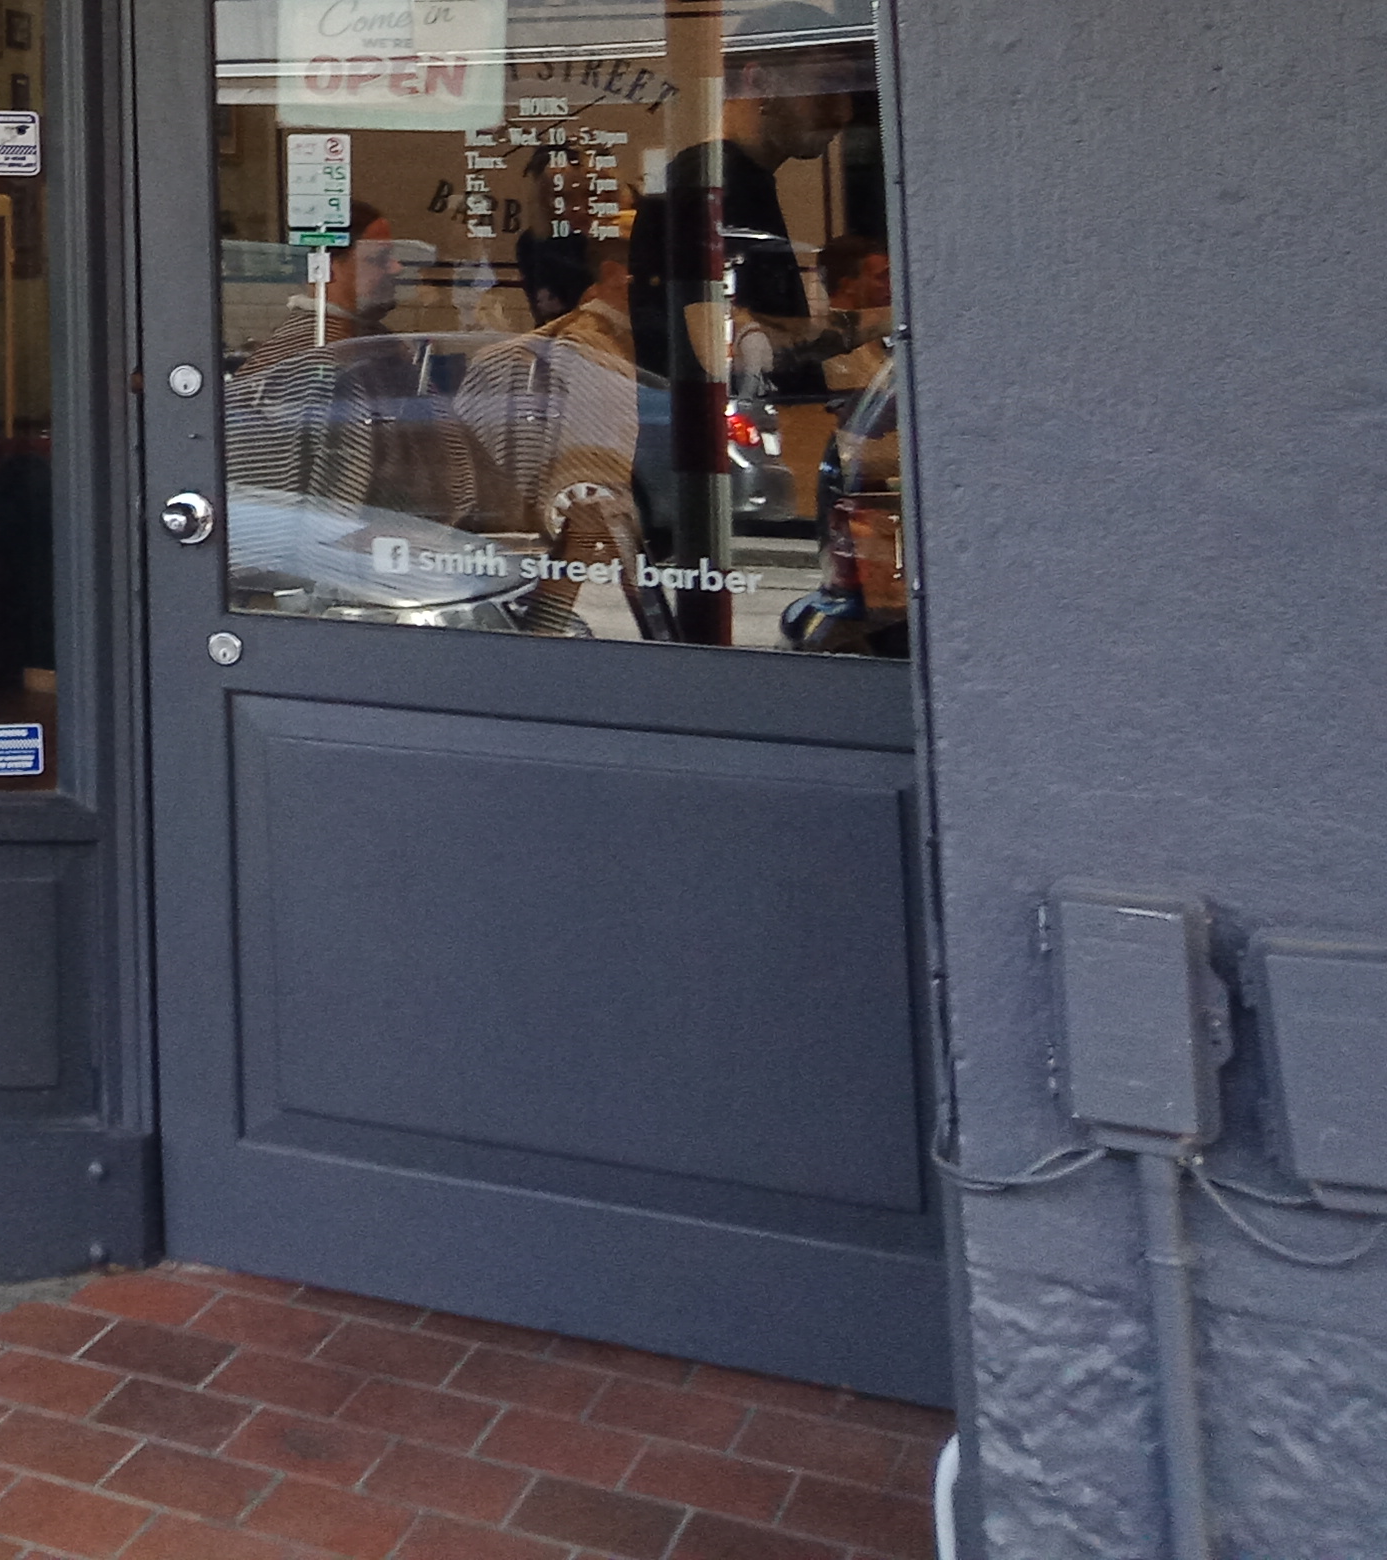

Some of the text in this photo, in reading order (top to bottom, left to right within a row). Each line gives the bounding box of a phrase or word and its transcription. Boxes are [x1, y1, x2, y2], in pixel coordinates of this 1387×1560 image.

[423, 5, 455, 25] in
[303, 54, 468, 97] OPEN
[519, 97, 569, 116] HOURS
[508, 127, 541, 146] Wed.
[548, 127, 566, 145] 10
[464, 151, 508, 169] Thurs.
[549, 150, 568, 168] 10
[585, 150, 618, 171] 7pm
[465, 174, 490, 192] Fri.
[553, 175, 564, 191] 9
[586, 174, 618, 194] 7pm
[554, 198, 565, 215] 9
[588, 197, 620, 217] 5pm
[466, 220, 497, 238] Sun.
[551, 220, 570, 238] 10
[589, 220, 620, 240] 4pm
[418, 542, 508, 578] smith
[519, 549, 624, 586] street
[637, 554, 764, 594] barber
